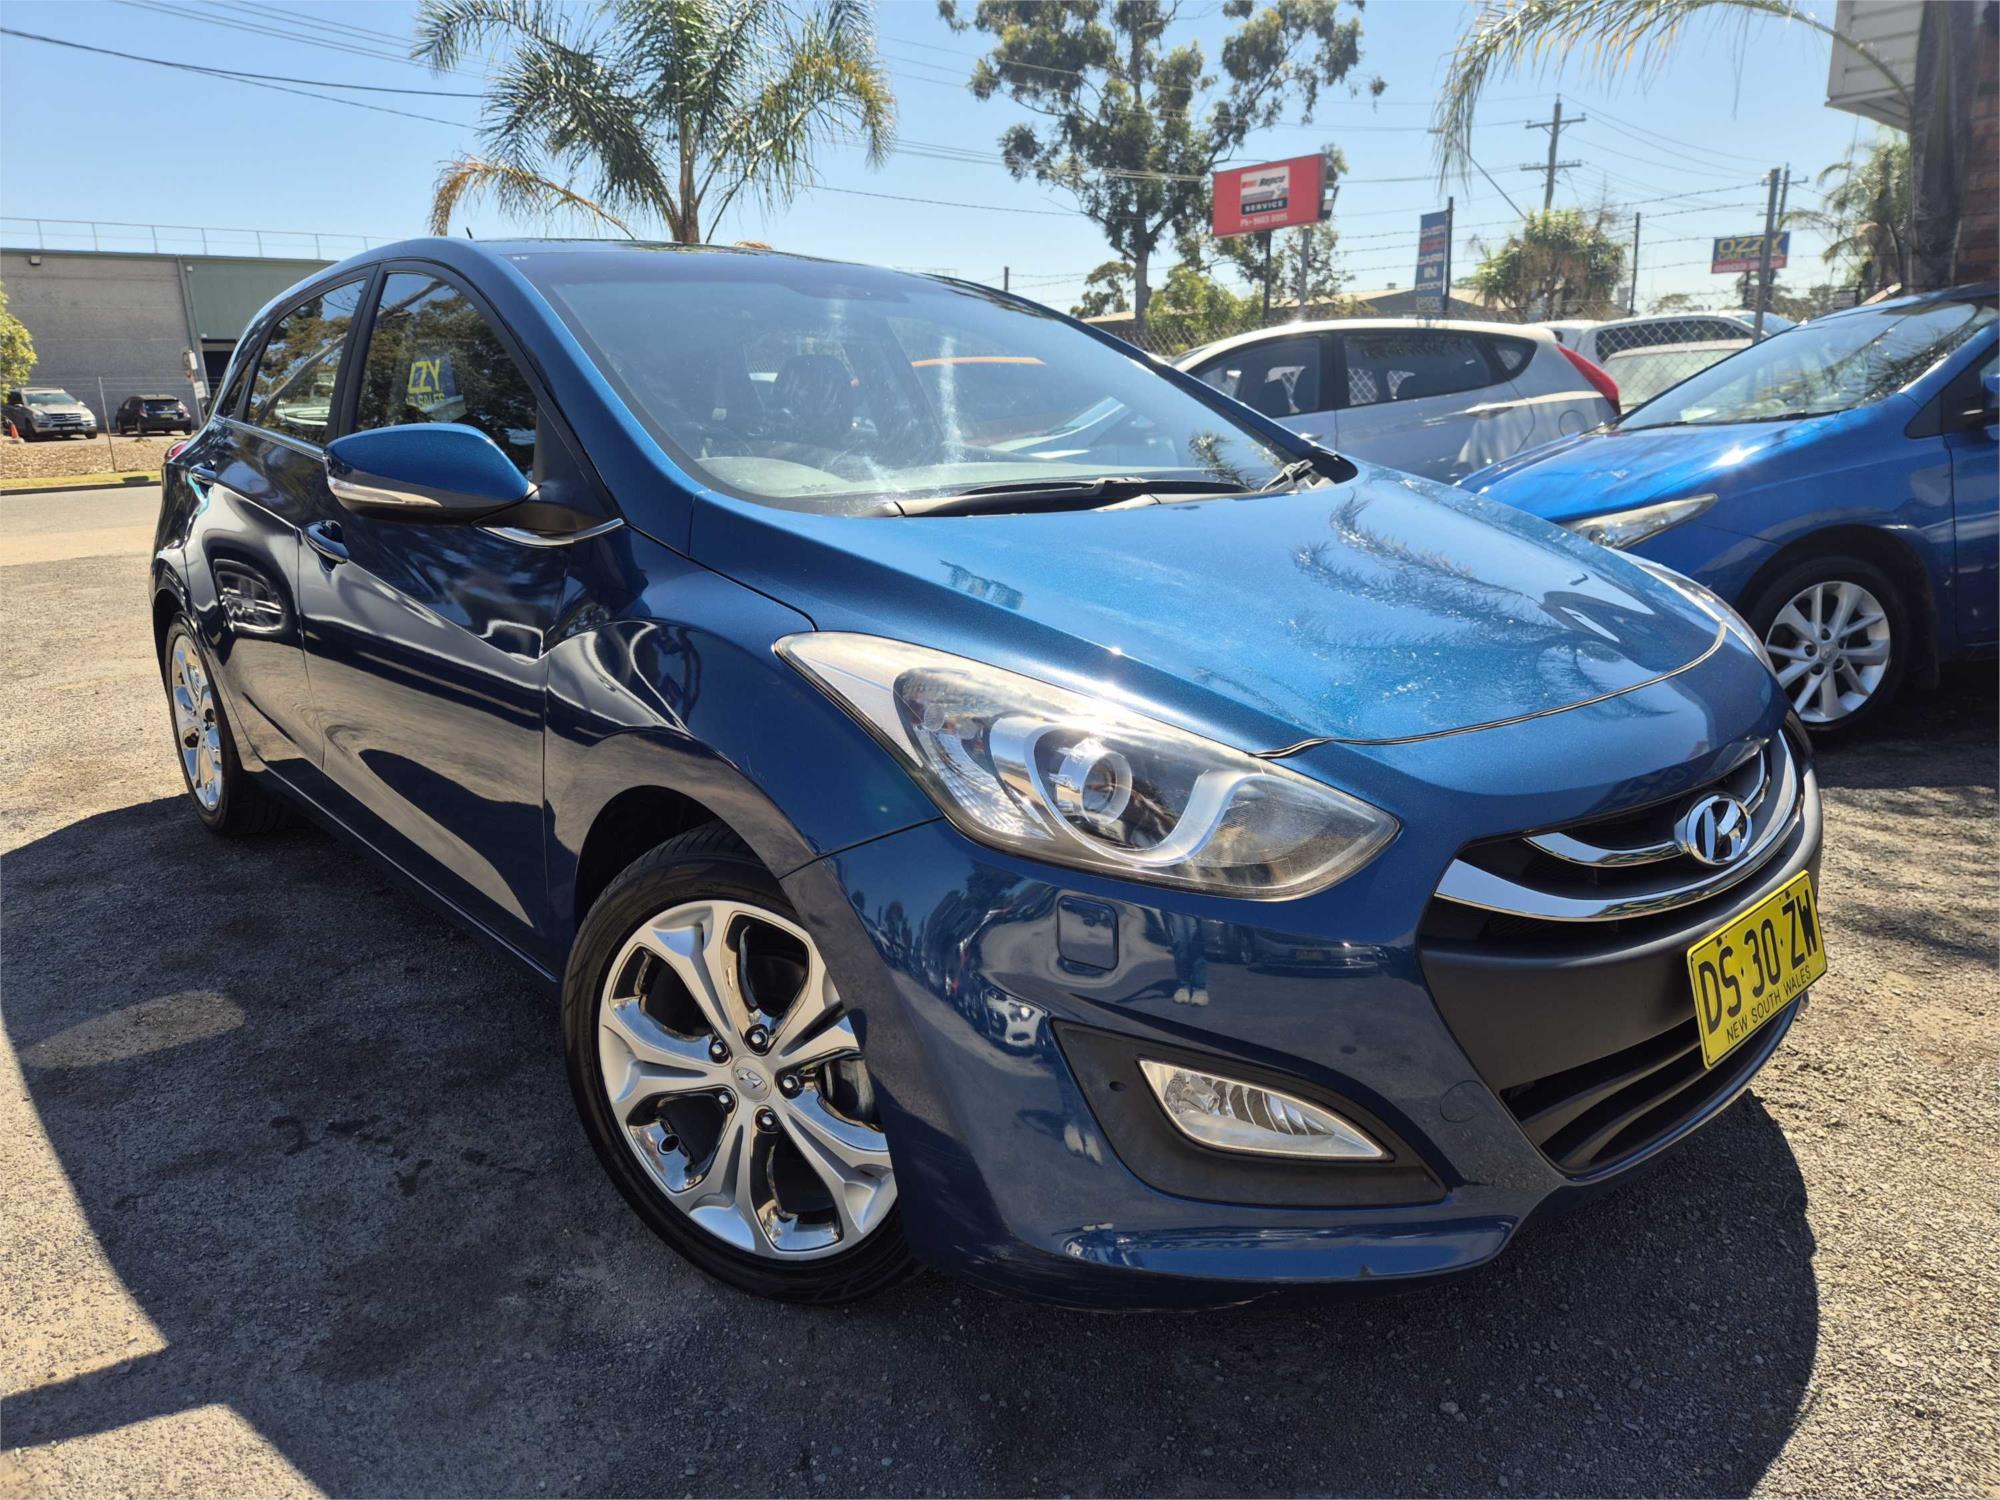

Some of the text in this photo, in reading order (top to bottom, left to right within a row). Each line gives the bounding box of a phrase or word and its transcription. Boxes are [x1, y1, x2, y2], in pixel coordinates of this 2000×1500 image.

[1244, 200, 1283, 212] SERVICE
[1725, 965, 1811, 1044] NEW SOUTH WALES
